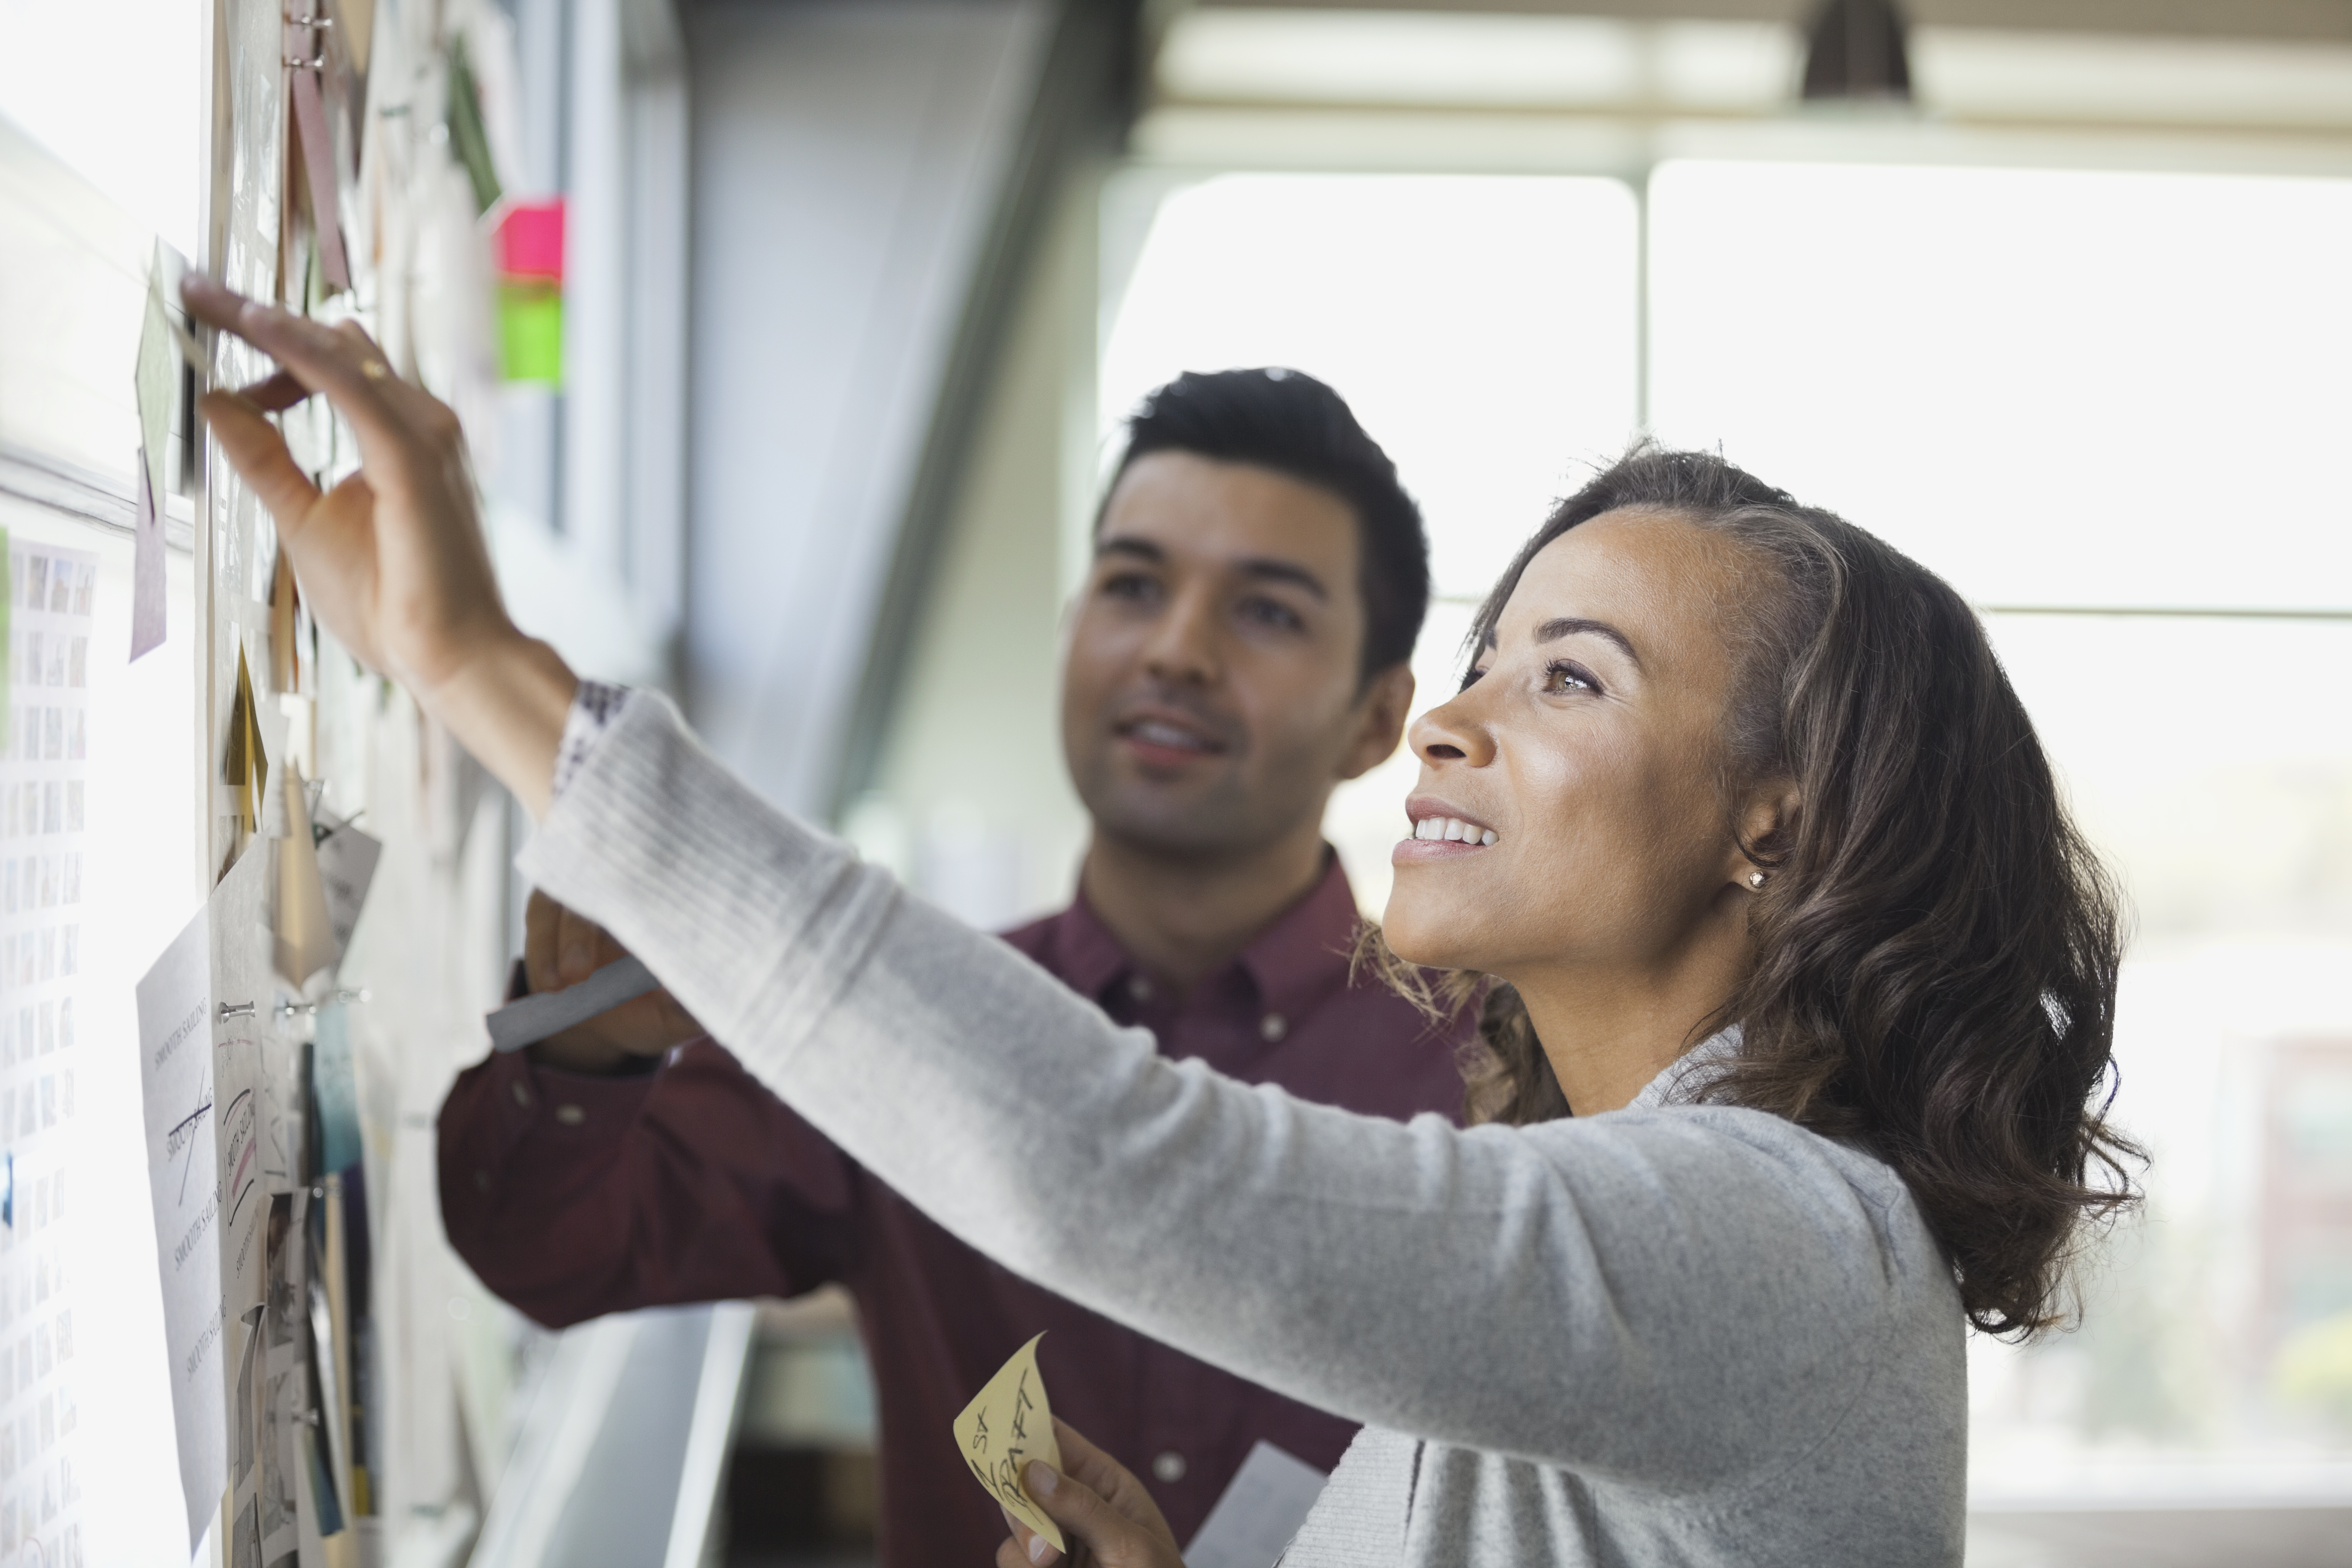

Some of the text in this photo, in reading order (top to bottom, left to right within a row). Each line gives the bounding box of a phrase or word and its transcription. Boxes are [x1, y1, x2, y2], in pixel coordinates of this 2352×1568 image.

[155, 997, 207, 1071] SMOOTH SAILING
[175, 1181, 222, 1271] SMOOTH SAILING
[187, 1294, 226, 1382] SMOOTH SAILING
